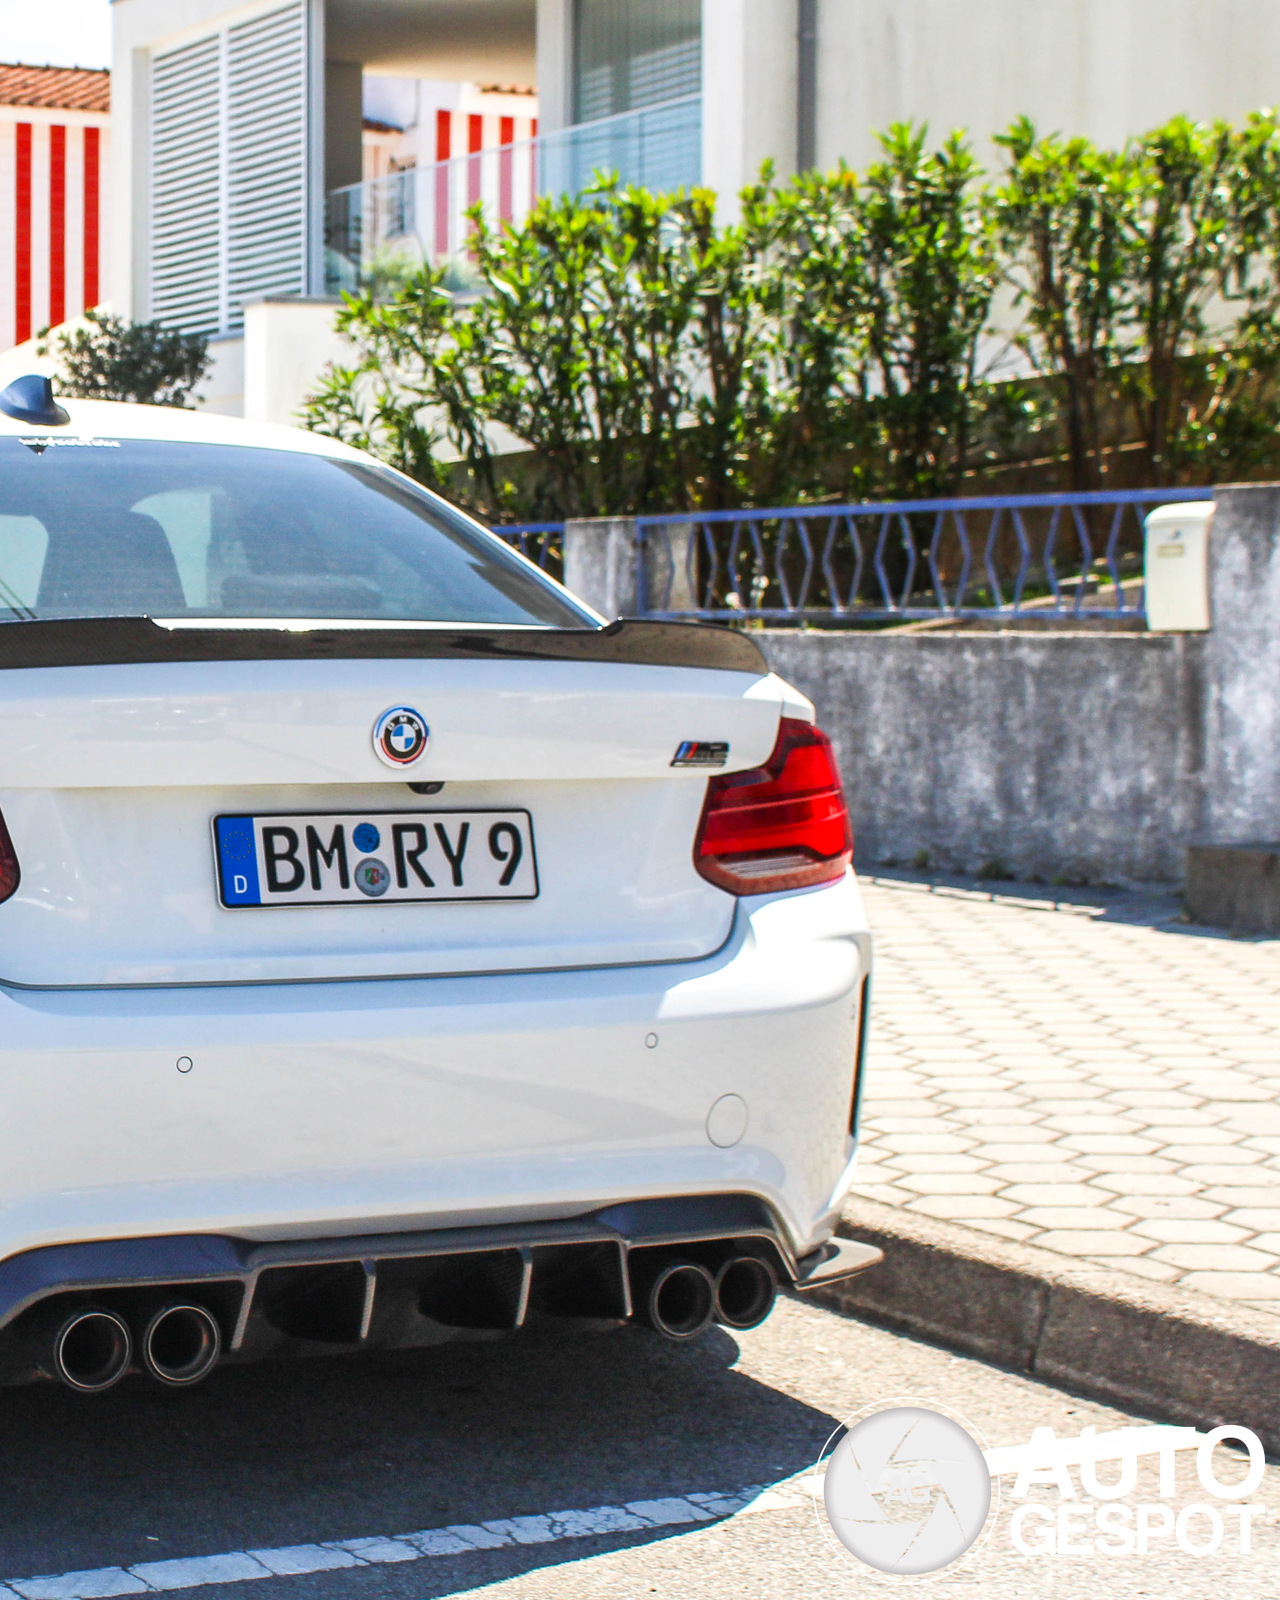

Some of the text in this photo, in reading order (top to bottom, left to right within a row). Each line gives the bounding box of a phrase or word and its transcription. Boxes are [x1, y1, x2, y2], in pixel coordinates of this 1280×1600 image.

[261, 821, 523, 893] BM RY 9
[233, 875, 248, 894] D
